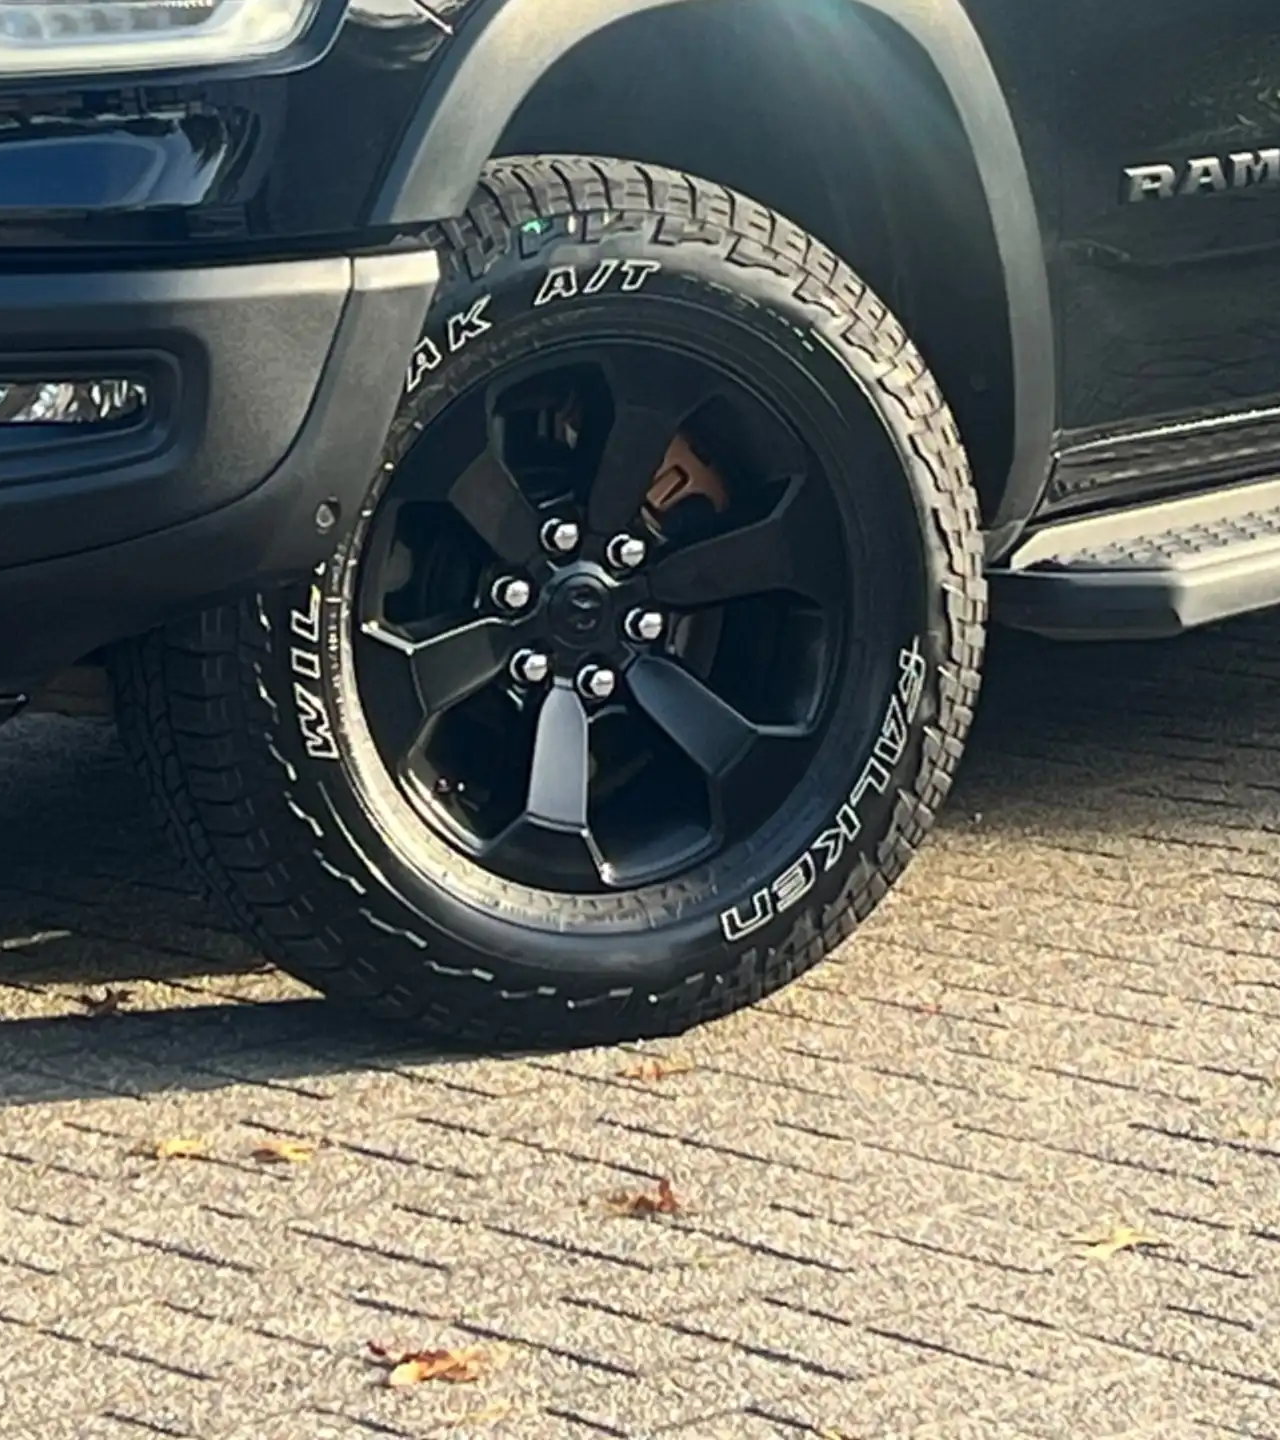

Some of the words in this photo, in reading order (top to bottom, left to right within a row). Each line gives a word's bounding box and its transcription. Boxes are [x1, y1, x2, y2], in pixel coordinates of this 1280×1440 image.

[534, 259, 661, 305] A/T
[290, 583, 342, 761] WIL
[721, 635, 926, 942] FALKEN
